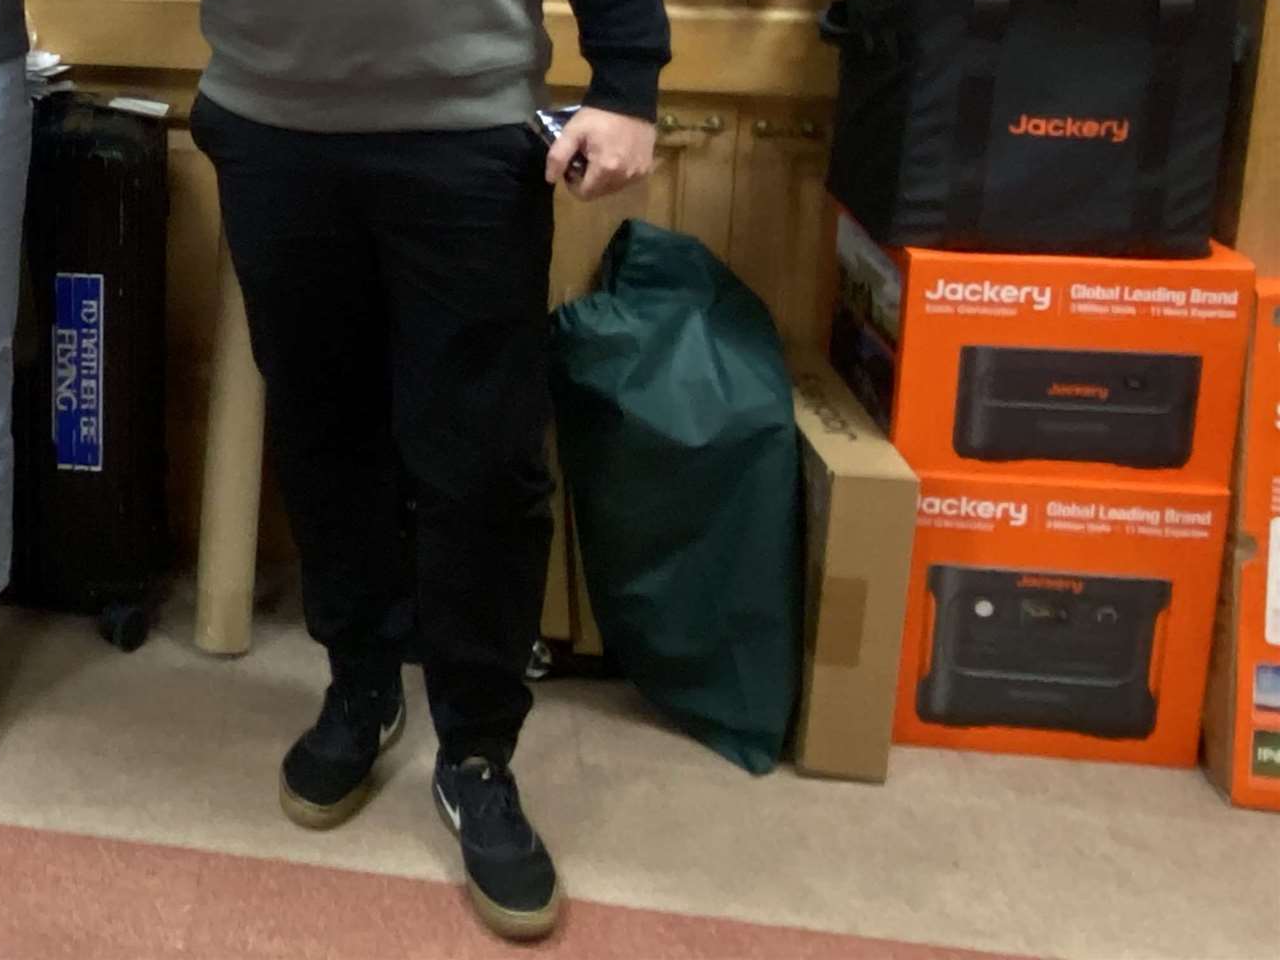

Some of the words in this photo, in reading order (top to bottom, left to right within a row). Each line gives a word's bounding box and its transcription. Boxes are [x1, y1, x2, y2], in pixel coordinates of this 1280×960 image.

[1008, 113, 1130, 143] Jackery
[924, 278, 1052, 311] Jackery
[1070, 283, 1120, 301] Global
[1123, 286, 1187, 306] Leading
[1190, 288, 1239, 306] Brand
